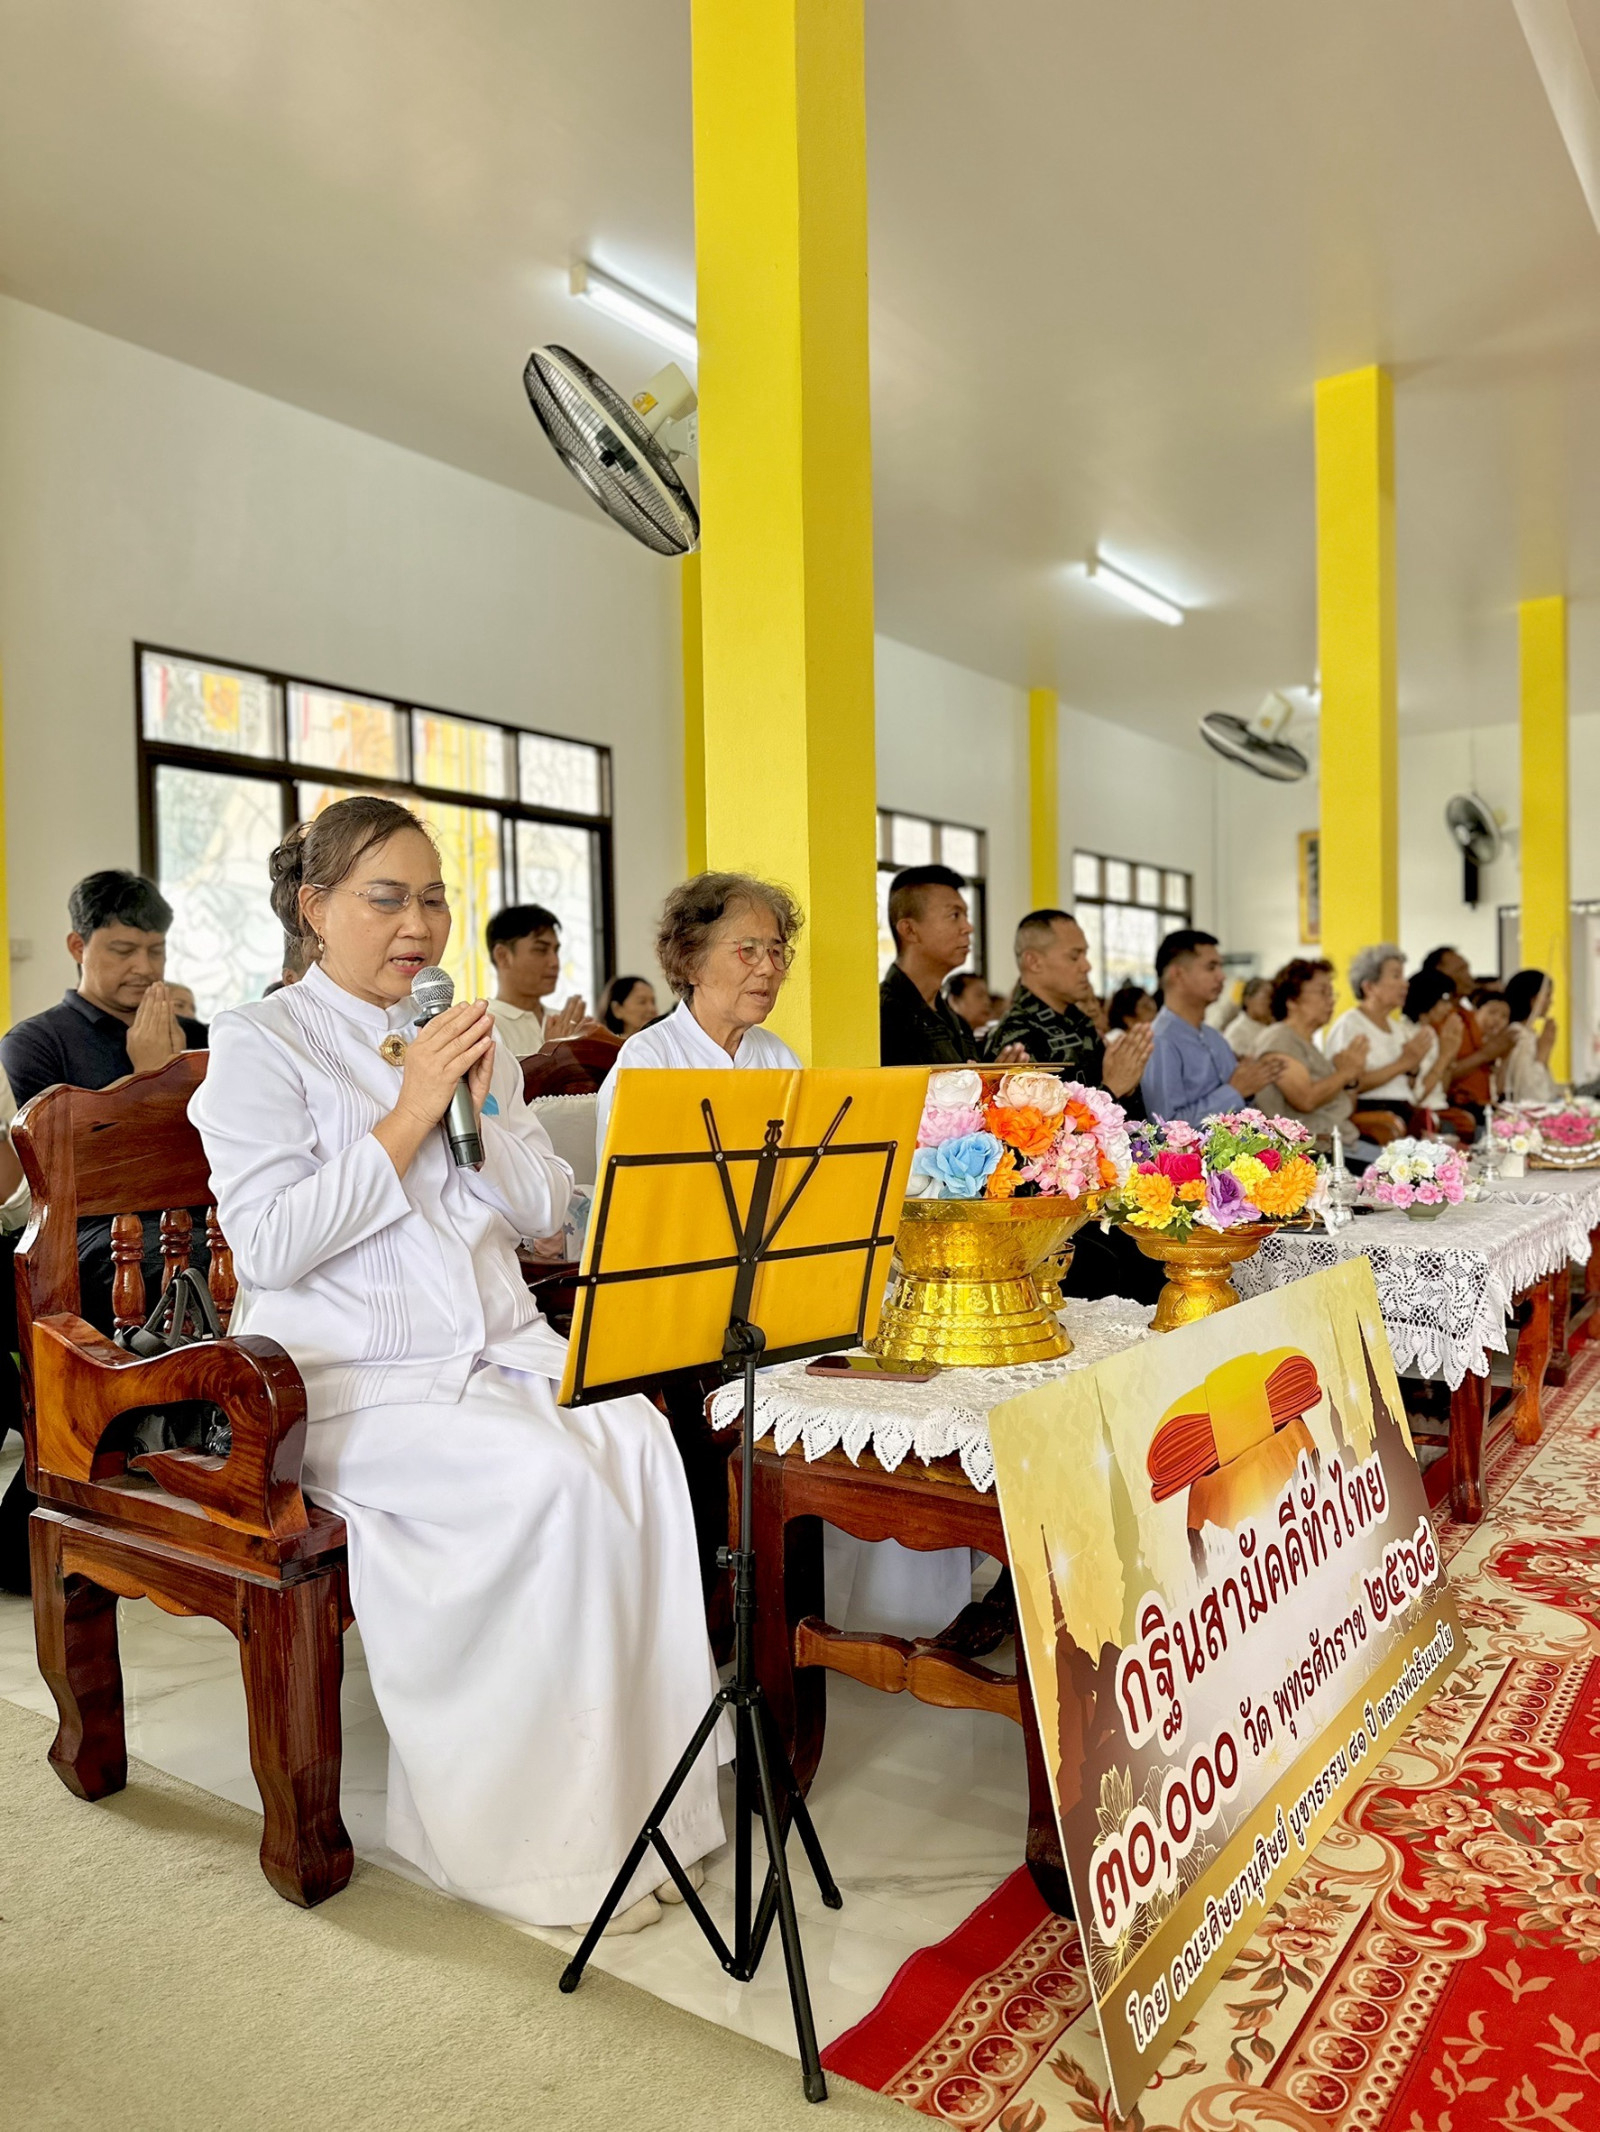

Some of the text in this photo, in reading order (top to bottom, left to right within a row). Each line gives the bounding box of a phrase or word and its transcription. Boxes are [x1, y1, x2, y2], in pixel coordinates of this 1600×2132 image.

[1096, 1525, 1436, 1929] ๓๐,๐๐๐ วัด พุทธศักราช ๒๕๖๘
[1121, 1460, 1387, 1741] กฐินสามัคคีทั่วไทย
[1128, 1986, 1168, 2047] โดย
[1172, 1809, 1288, 1995] คณะศิษยานุศิษย์
[1289, 1748, 1348, 1847] บูชาธรรม
[1365, 1704, 1379, 1738] ปี
[1377, 1623, 1453, 1726] หลวงพ่อธัมมชโย
